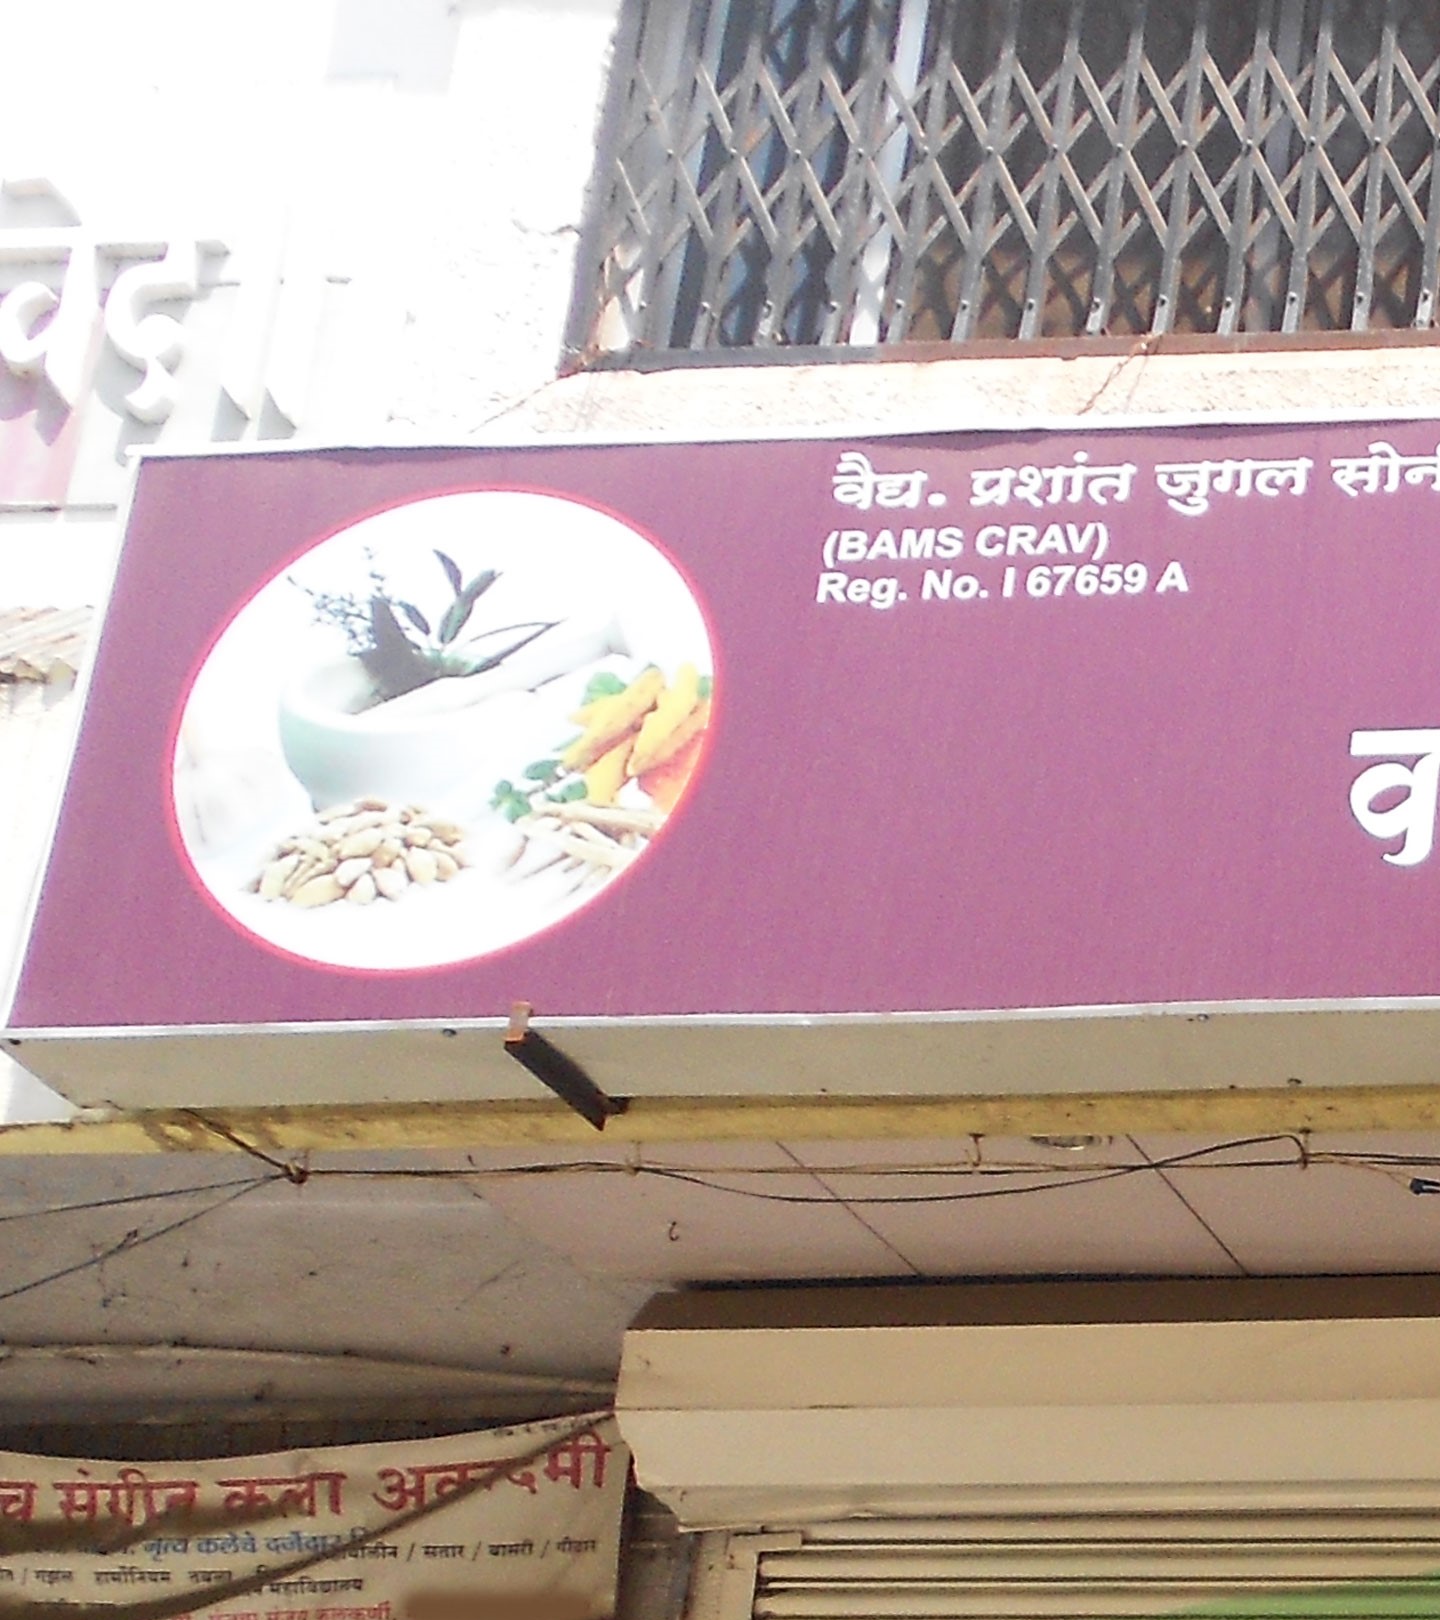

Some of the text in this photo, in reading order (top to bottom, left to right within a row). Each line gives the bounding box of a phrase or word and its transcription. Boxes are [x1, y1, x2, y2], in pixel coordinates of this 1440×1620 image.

[832, 451, 947, 509] वैद्य.
[969, 452, 1138, 508] प्रशांत
[1154, 454, 1314, 516] जुगल
[822, 522, 1109, 566] (BAMS CRAV)
[815, 570, 908, 608] Reg.
[920, 567, 990, 602] No.
[1026, 561, 1149, 596] 67659
[1155, 561, 1189, 593] A
[215, 1471, 347, 1517] कला
